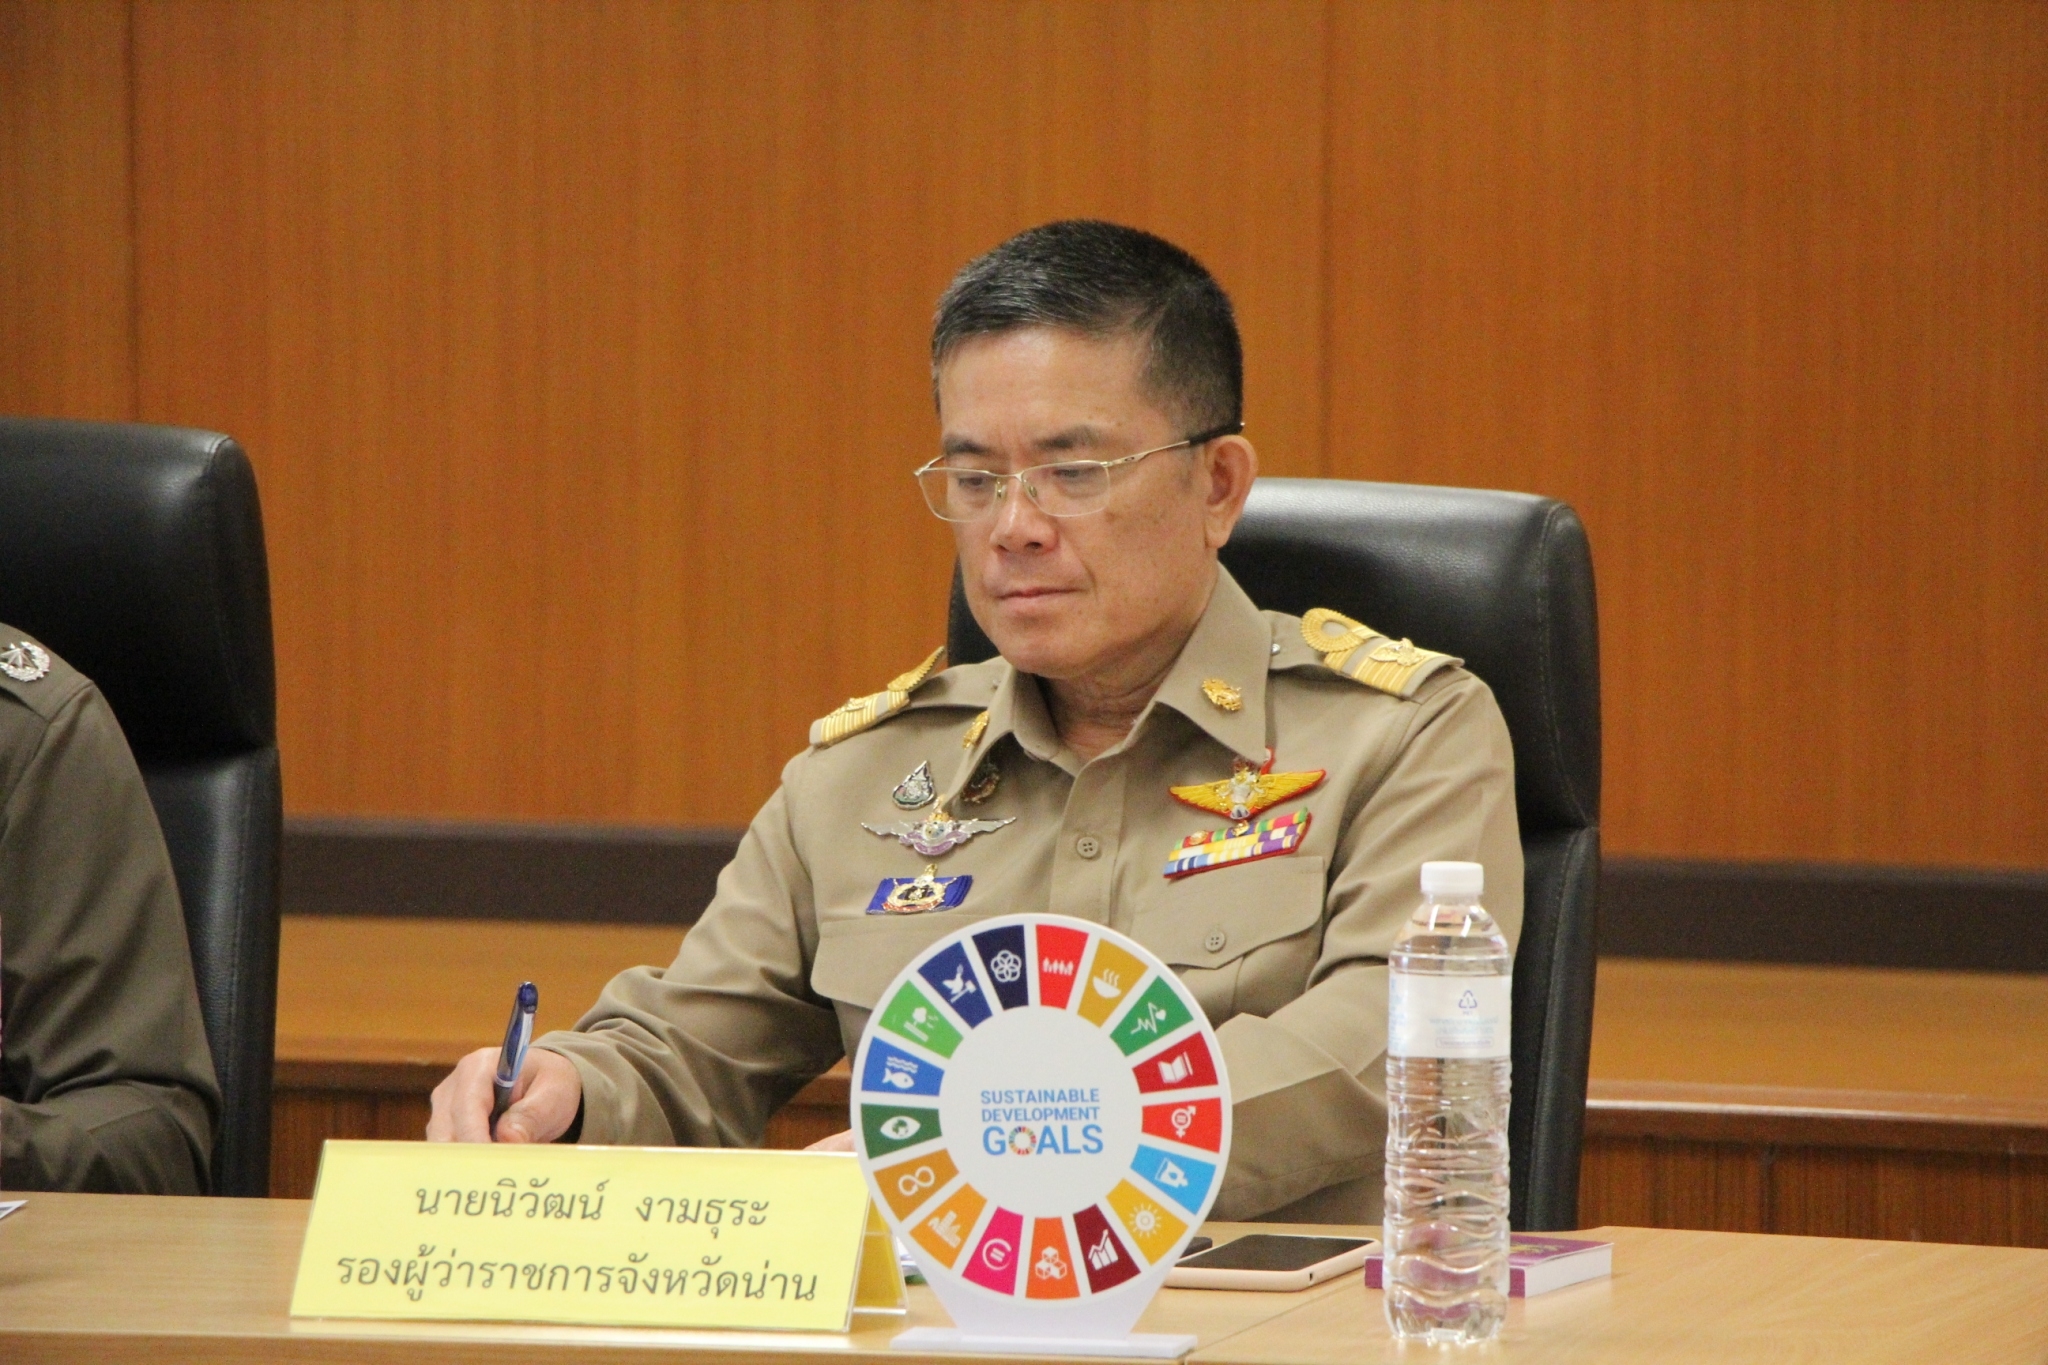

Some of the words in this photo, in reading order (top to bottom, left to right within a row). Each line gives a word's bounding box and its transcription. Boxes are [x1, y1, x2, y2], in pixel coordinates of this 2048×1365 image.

[980, 1088, 1100, 1104] SUSTAINABLE
[981, 1106, 1100, 1122] DEVELOPMENT
[982, 1123, 1104, 1156] GOALS
[416, 1177, 609, 1220] นายนิวัฒน์
[635, 1196, 770, 1239] งามธุระ
[337, 1244, 817, 1302] รองผู้ว่าราชการจังหวัดน่าน
